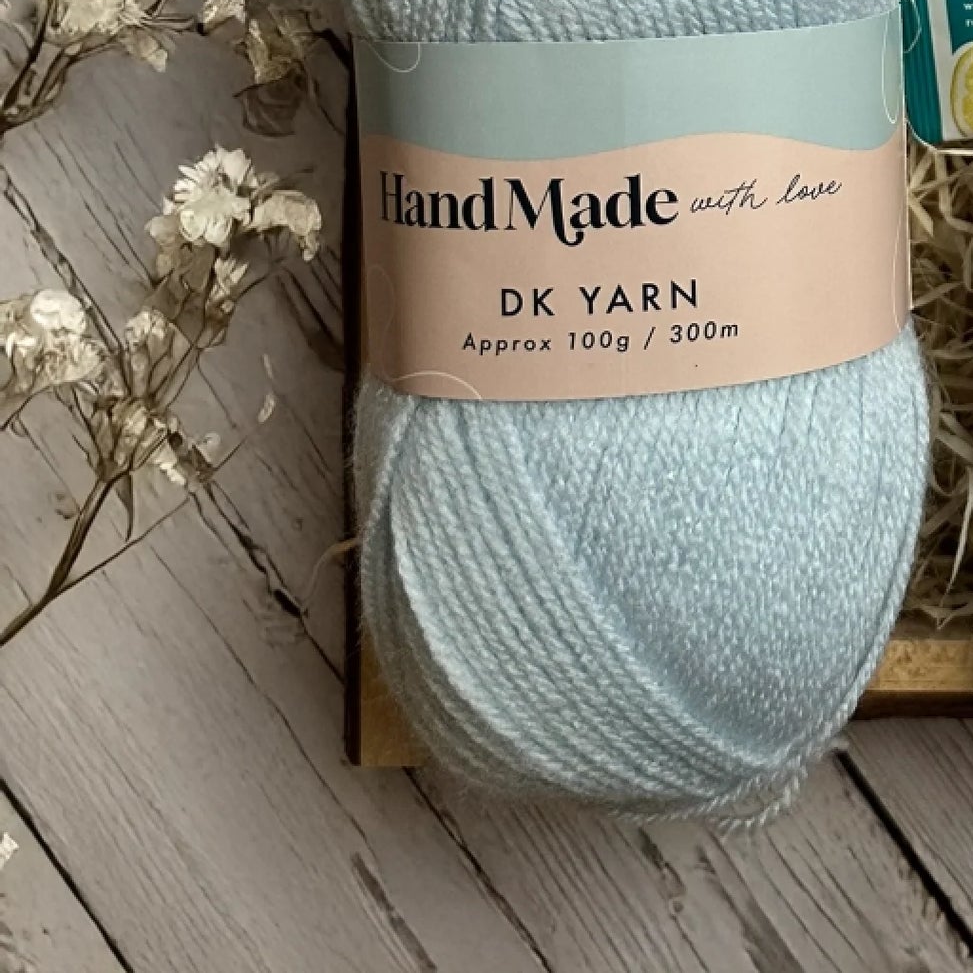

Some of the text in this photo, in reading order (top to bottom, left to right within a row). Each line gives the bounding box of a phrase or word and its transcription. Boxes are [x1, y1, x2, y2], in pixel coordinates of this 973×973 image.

[690, 179, 768, 214] with
[777, 173, 843, 204] love
[500, 278, 699, 317] DK YARN
[462, 321, 740, 355] Approx 100g / 300m
